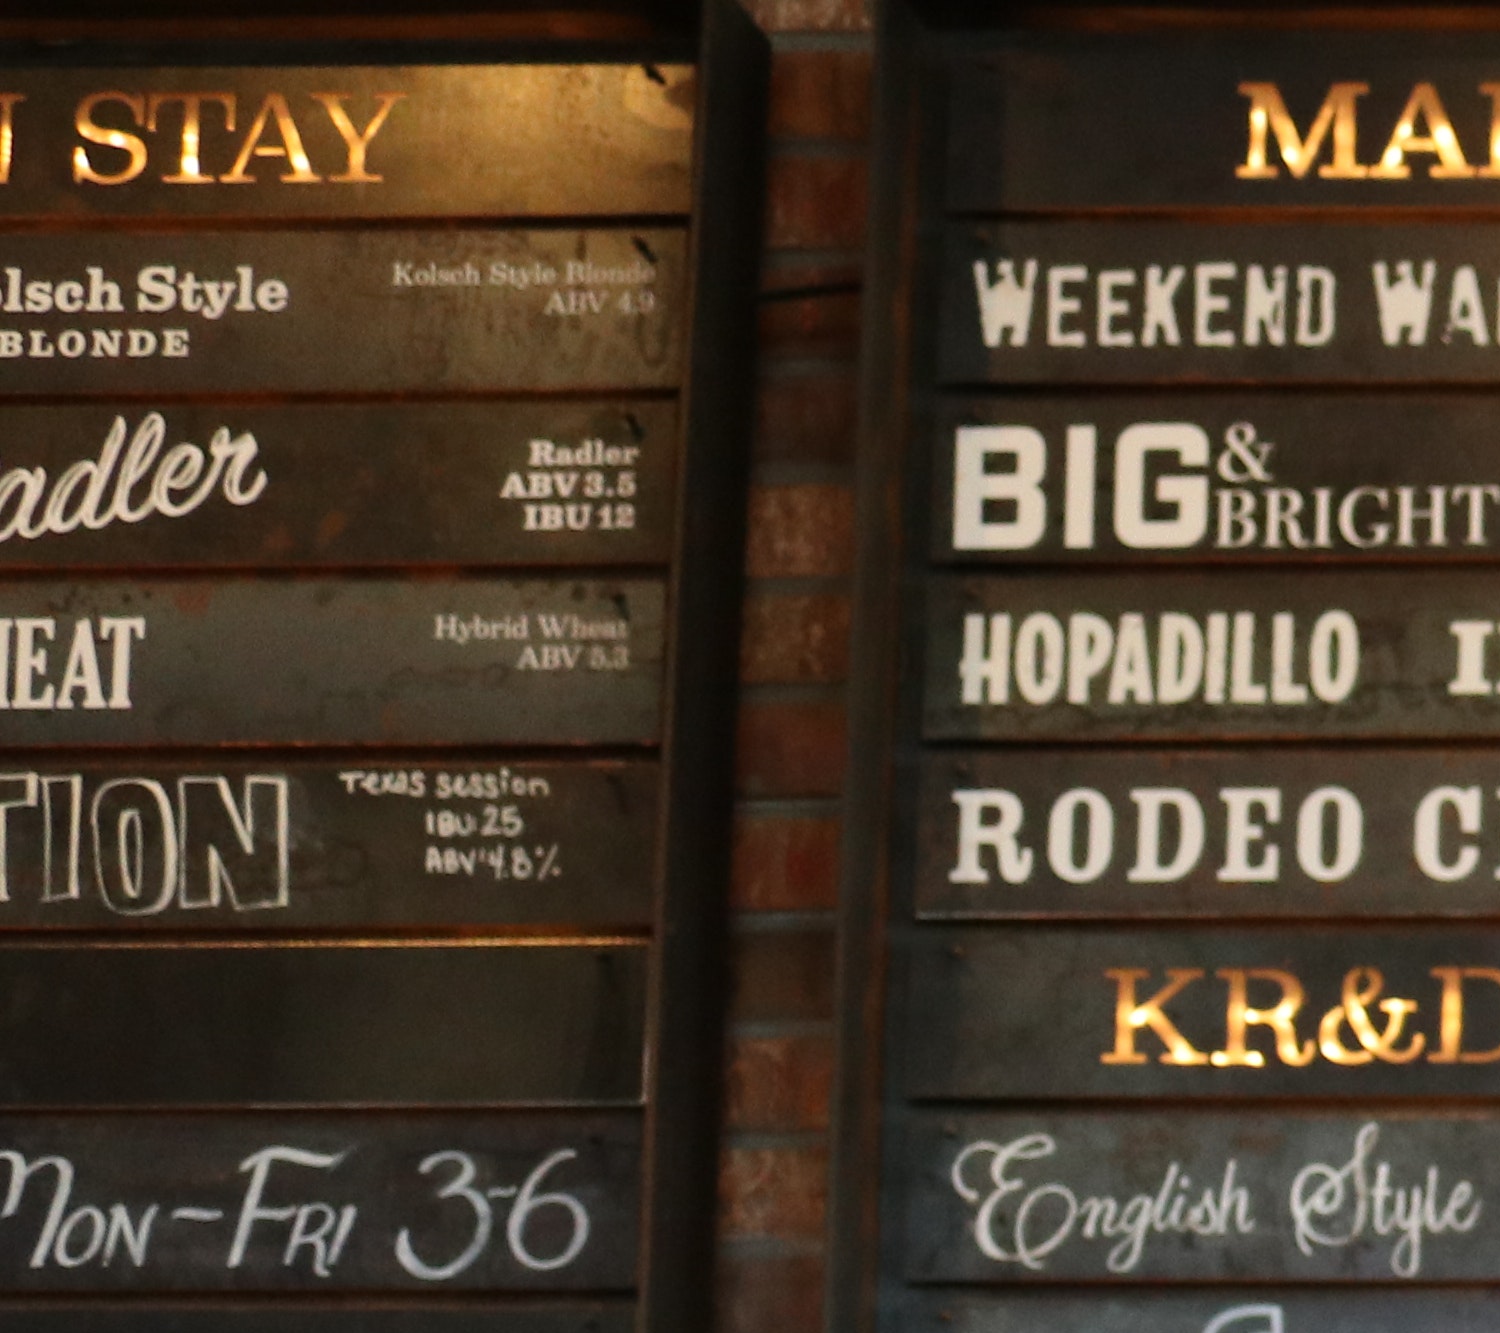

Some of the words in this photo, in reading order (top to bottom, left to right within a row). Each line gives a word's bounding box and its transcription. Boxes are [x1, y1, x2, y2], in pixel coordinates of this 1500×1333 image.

[74, 91, 407, 186] STAY
[0, 265, 130, 314] lsch
[137, 264, 289, 320] Style
[391, 261, 481, 287] Kolsch
[972, 257, 1337, 350] WEEKEND
[0, 330, 190, 358] BLONDE
[527, 438, 640, 467] Radler
[500, 472, 578, 499] ABV
[583, 472, 637, 498] 3.5
[953, 421, 1210, 551] BIG
[1215, 420, 1275, 484] &
[522, 504, 592, 531] IBU
[597, 504, 636, 530] 12
[434, 613, 529, 644] Hybrid
[958, 608, 1361, 706] HOPADILLO
[947, 785, 1365, 885] RODEO
[951, 1132, 1256, 1274] English
[1290, 1121, 1483, 1278] Style
